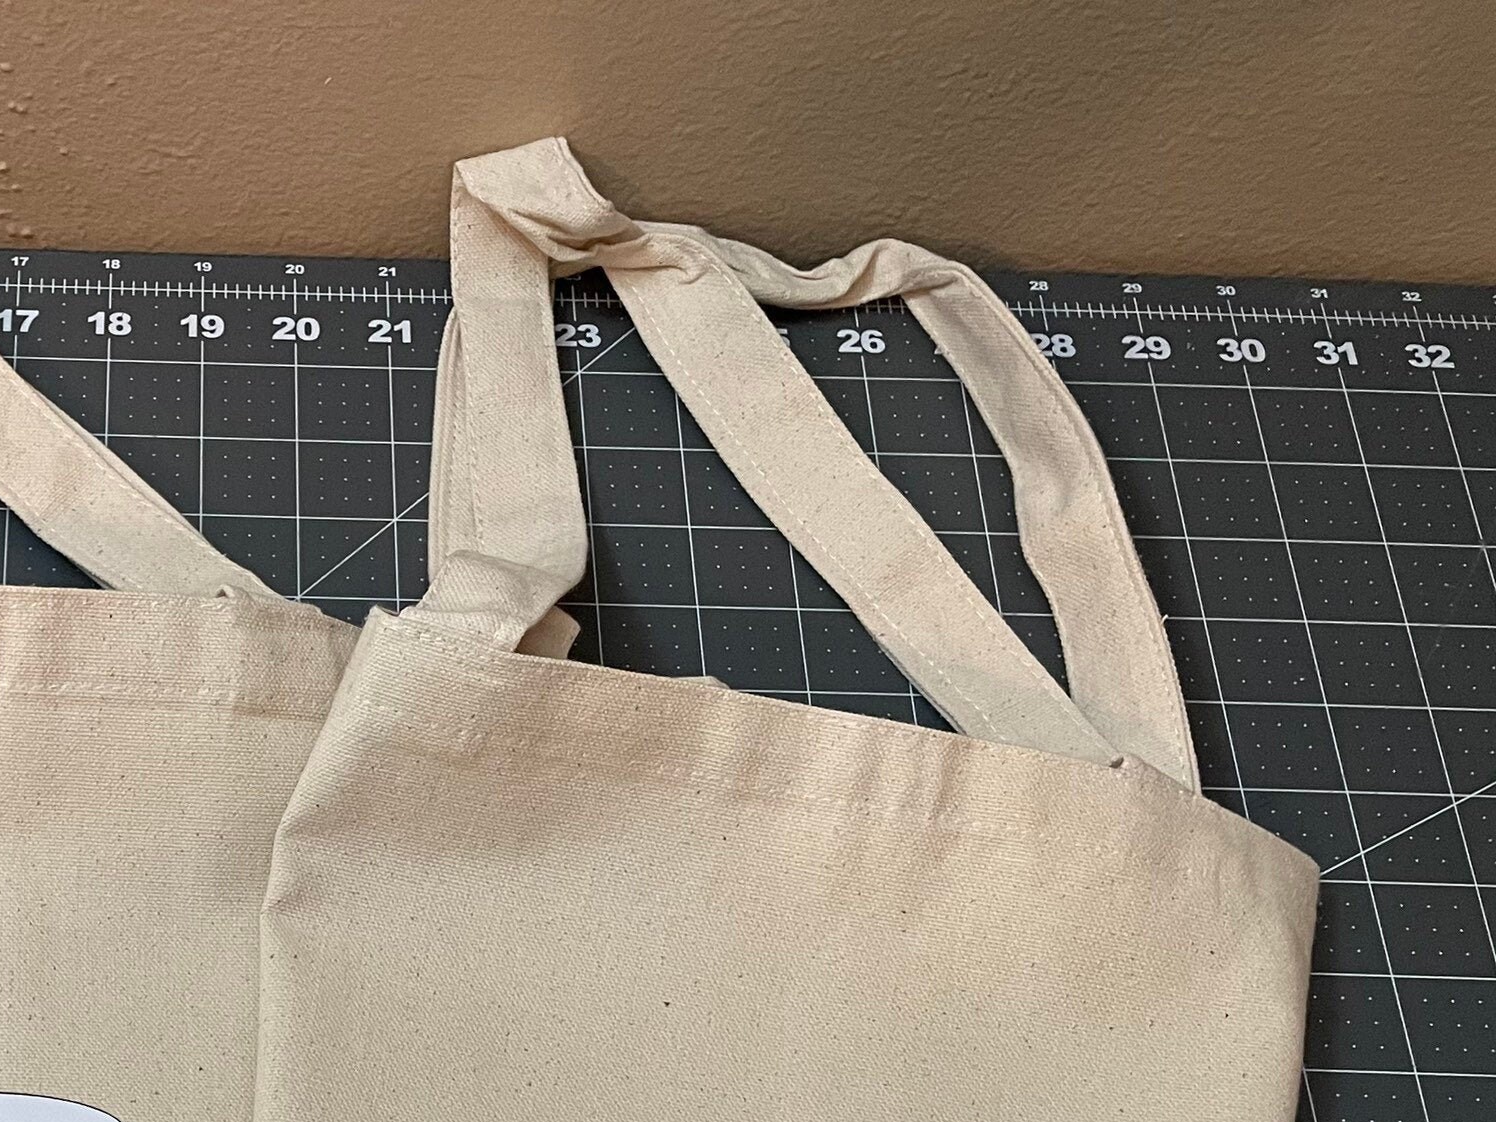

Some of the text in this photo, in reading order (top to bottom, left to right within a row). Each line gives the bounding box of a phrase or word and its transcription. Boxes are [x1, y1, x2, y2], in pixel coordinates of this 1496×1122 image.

[10, 256, 30, 267] 17
[102, 258, 121, 270] 18
[193, 261, 213, 272] 19
[284, 263, 305, 275] 20
[377, 266, 397, 277] 21
[1028, 280, 1049, 291] 28
[1121, 283, 1143, 294] 29
[1215, 285, 1237, 296] 30
[1309, 288, 1329, 299] 31
[1401, 291, 1423, 302] 32
[87, 311, 132, 336] 18
[180, 313, 225, 339] 19
[271, 316, 321, 341] 20
[367, 319, 412, 344] 21
[555, 323, 602, 348] 23
[836, 328, 886, 354] 26
[1031, 333, 1077, 358] 28
[1121, 335, 1172, 360] 29
[1216, 337, 1266, 363] 30
[1313, 340, 1359, 366] 31
[1404, 343, 1456, 369] 32
